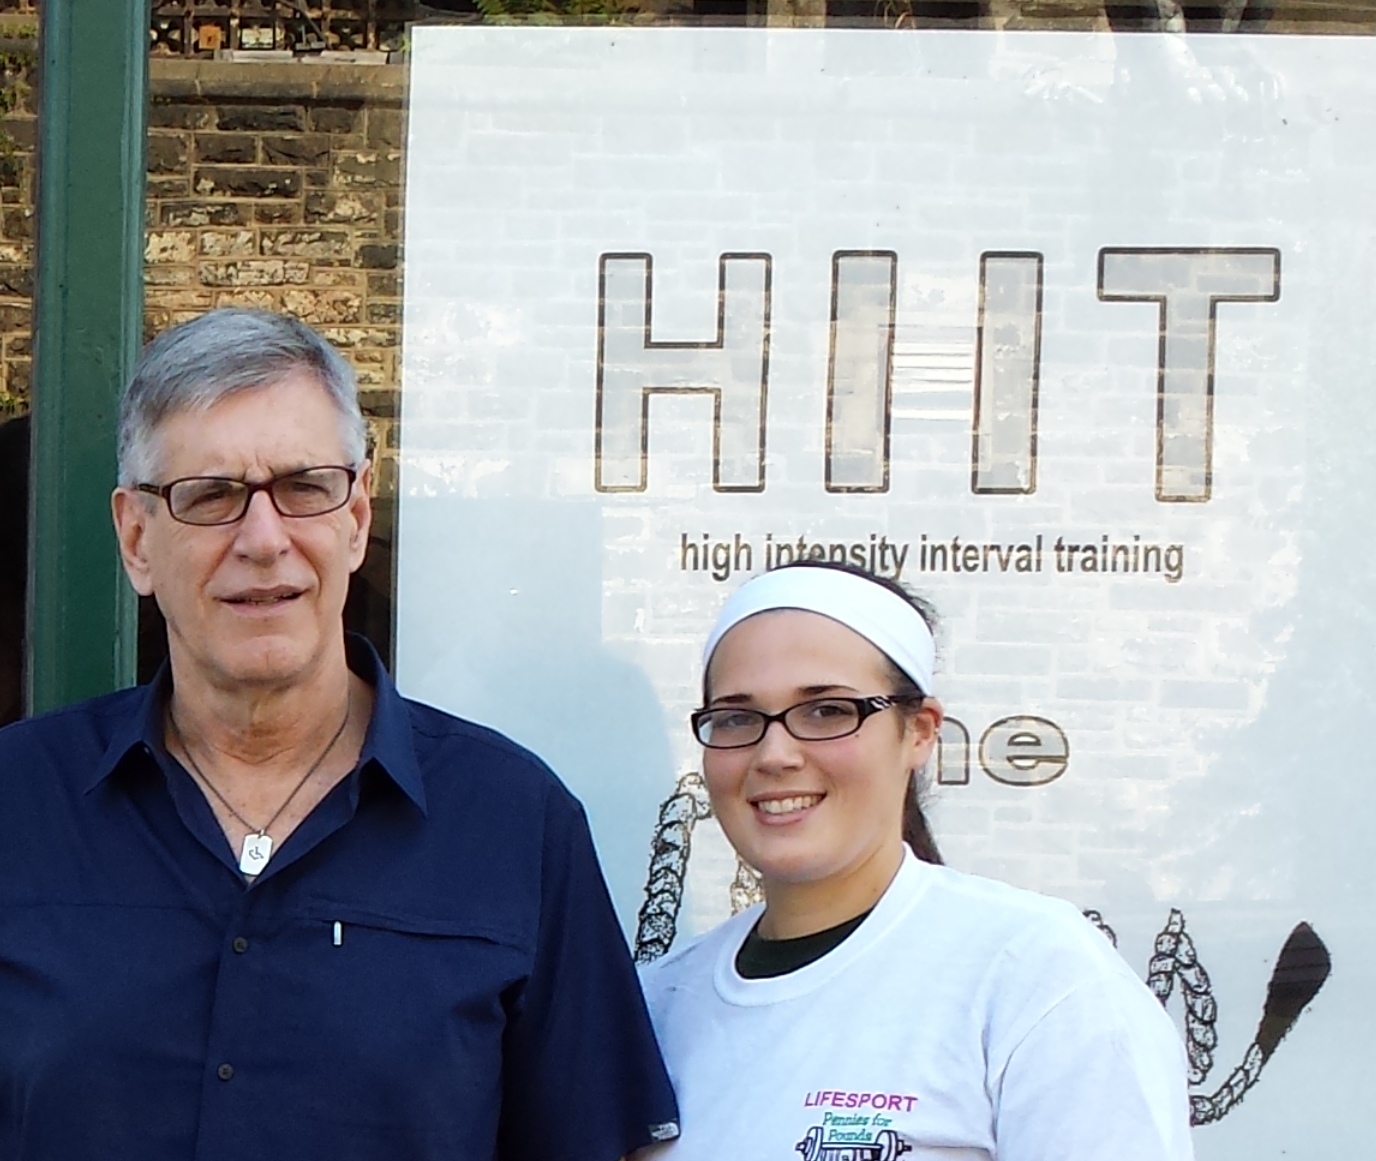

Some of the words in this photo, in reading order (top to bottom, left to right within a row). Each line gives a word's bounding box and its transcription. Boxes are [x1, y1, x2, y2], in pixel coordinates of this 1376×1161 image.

[594, 246, 1281, 503] HIIT
[680, 533, 752, 582] high
[765, 533, 909, 580] intensity
[920, 534, 1043, 573] interval
[1054, 534, 1184, 583] training
[804, 1091, 918, 1113] LIFESPORT
